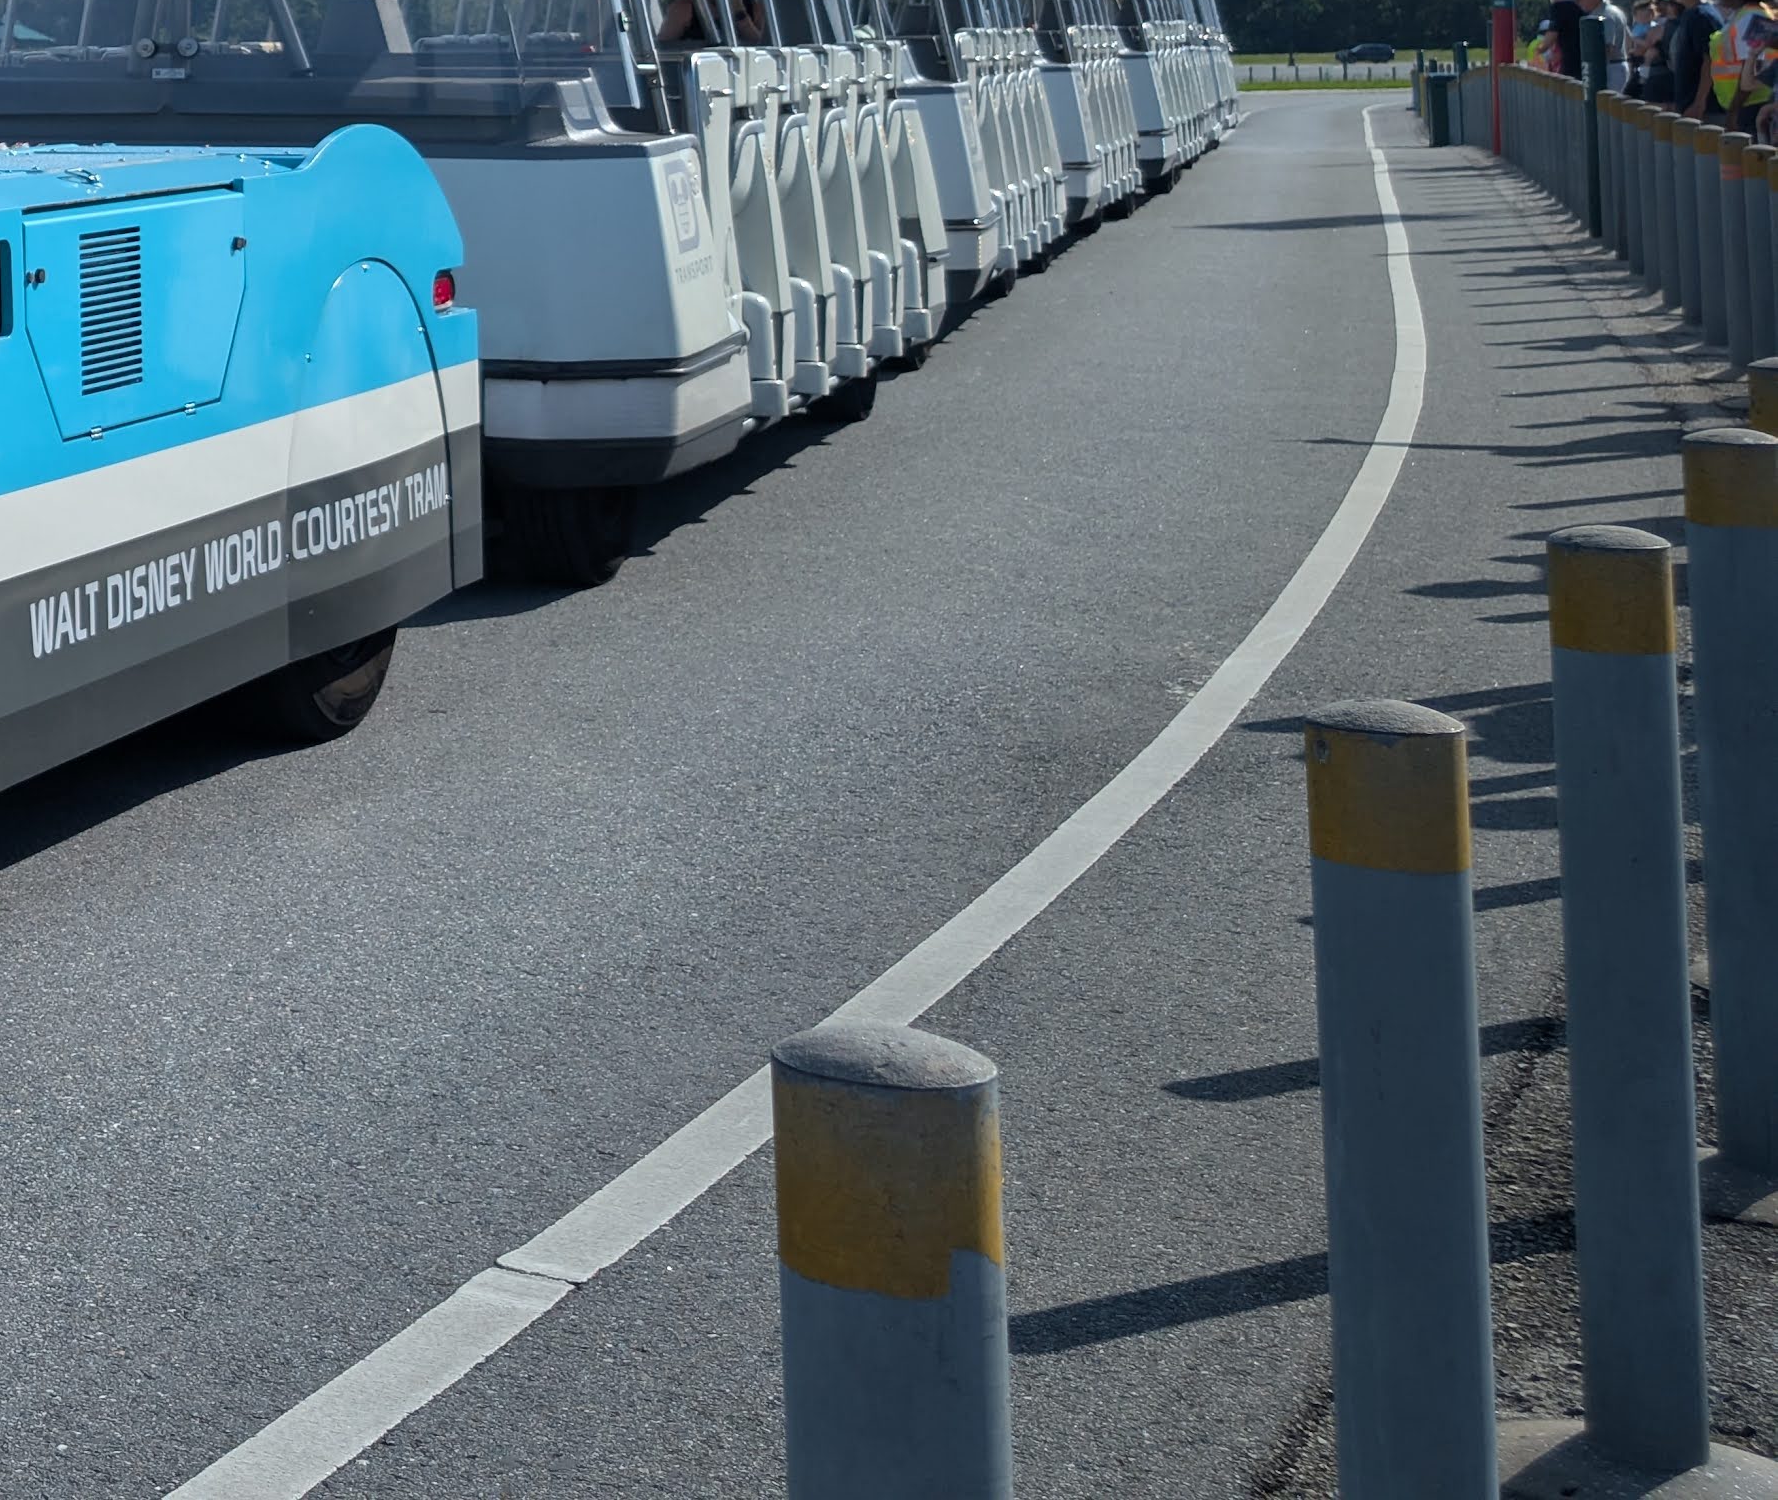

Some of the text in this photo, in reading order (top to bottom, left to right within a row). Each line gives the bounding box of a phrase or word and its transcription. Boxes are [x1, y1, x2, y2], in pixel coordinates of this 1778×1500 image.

[675, 255, 713, 284] TRANSPORT
[29, 462, 446, 658] WALT DISNEY WORLD COURTESY TRAM
